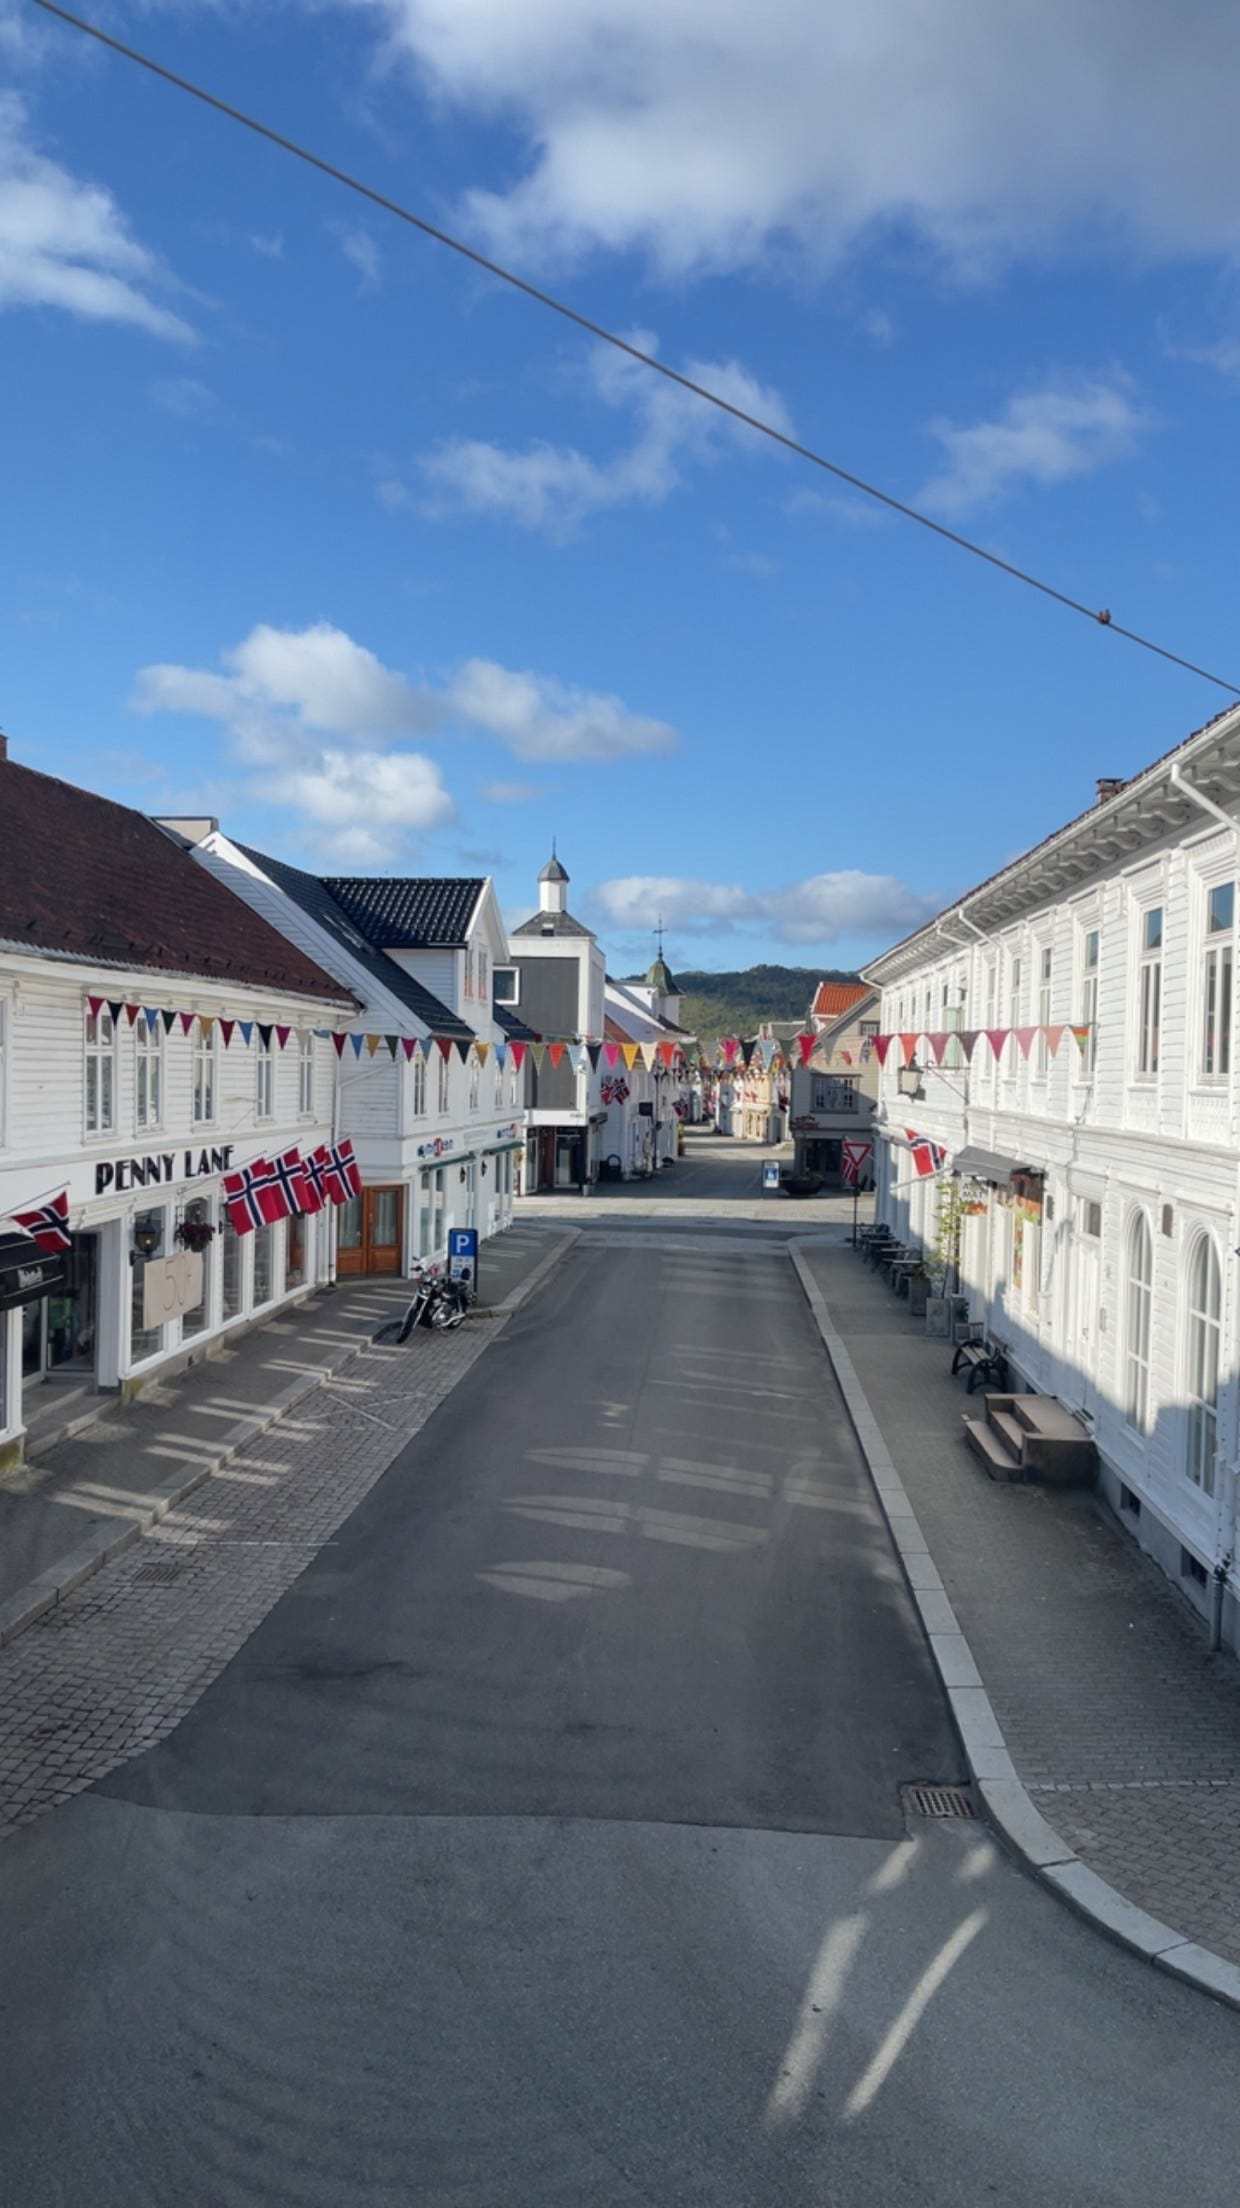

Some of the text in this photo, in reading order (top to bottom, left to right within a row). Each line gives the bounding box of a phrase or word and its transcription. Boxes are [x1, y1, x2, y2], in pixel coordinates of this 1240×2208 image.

[95, 1144, 235, 1196] PENNY LANE
[456, 1234, 470, 1254] P
